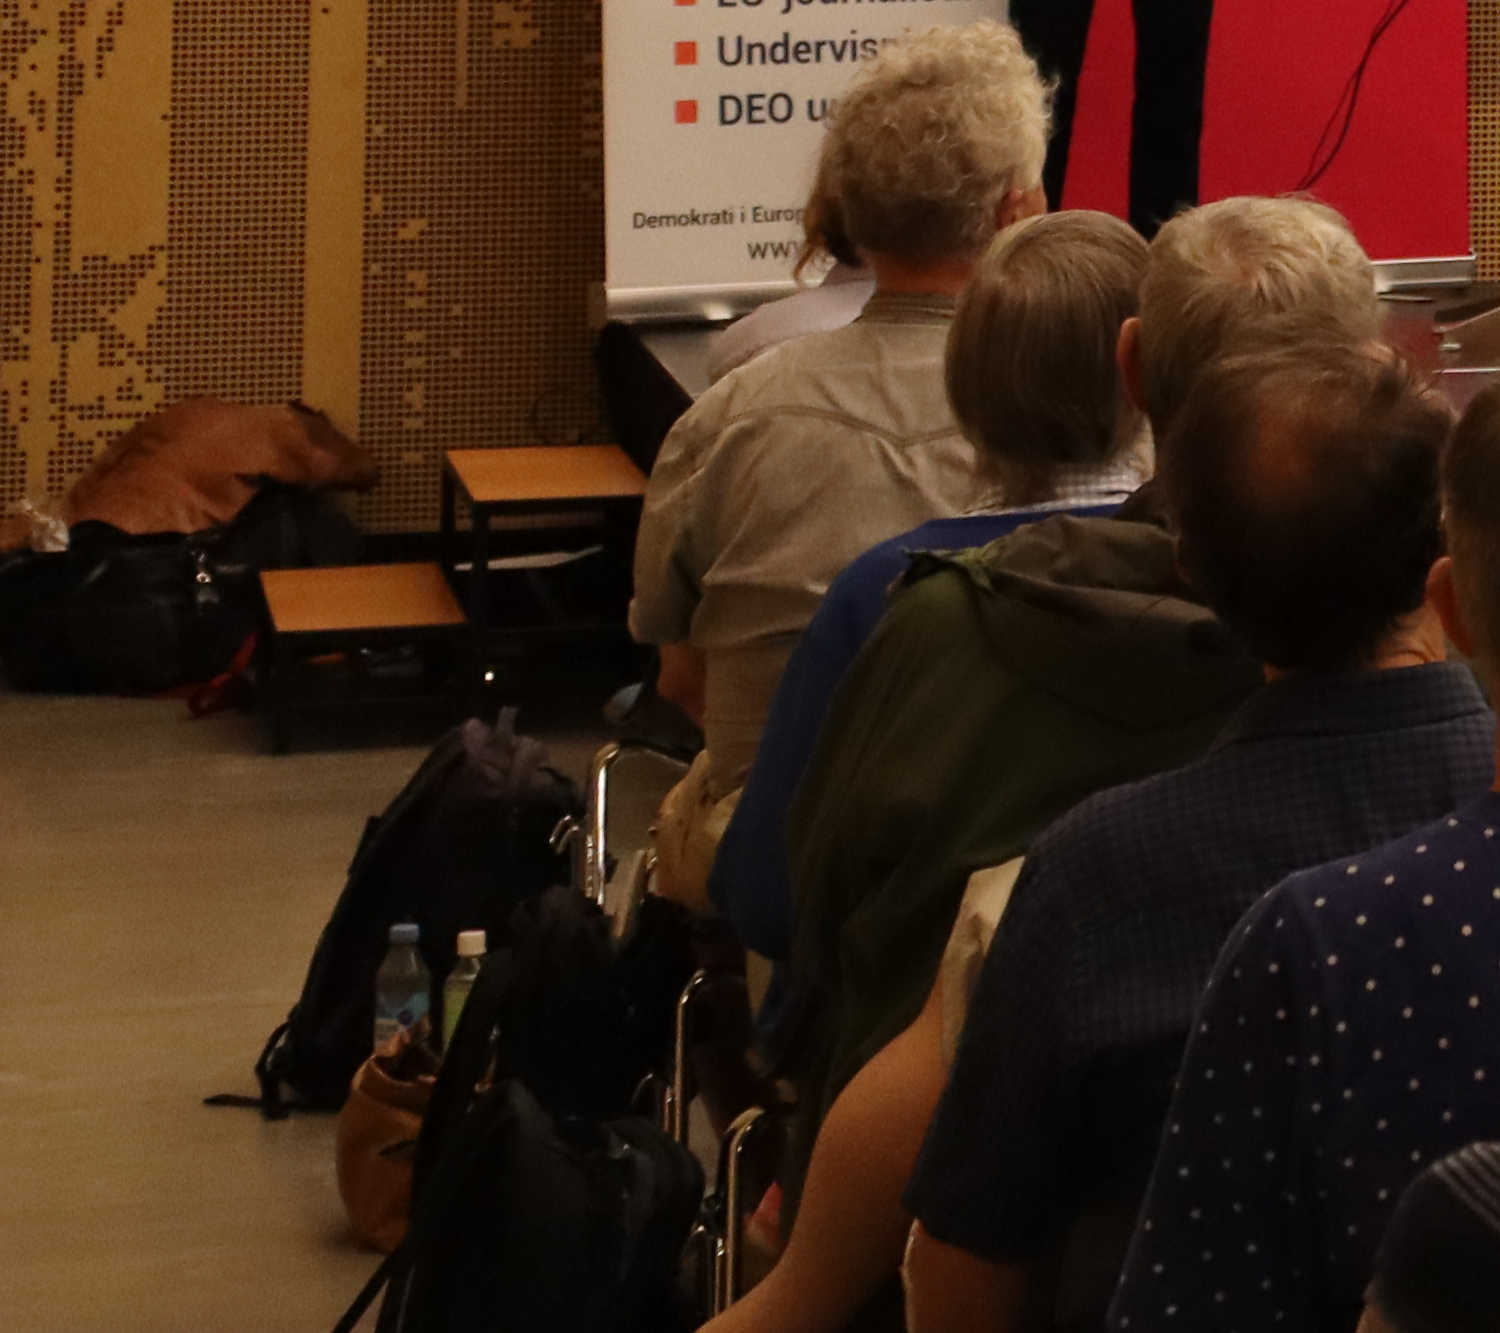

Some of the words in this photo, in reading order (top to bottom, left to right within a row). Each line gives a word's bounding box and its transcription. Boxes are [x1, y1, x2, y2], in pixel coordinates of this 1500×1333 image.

[717, 29, 892, 66] Undervis
[719, 91, 794, 125] DEO
[633, 207, 734, 229] Demokrati
[739, 206, 745, 223] i
